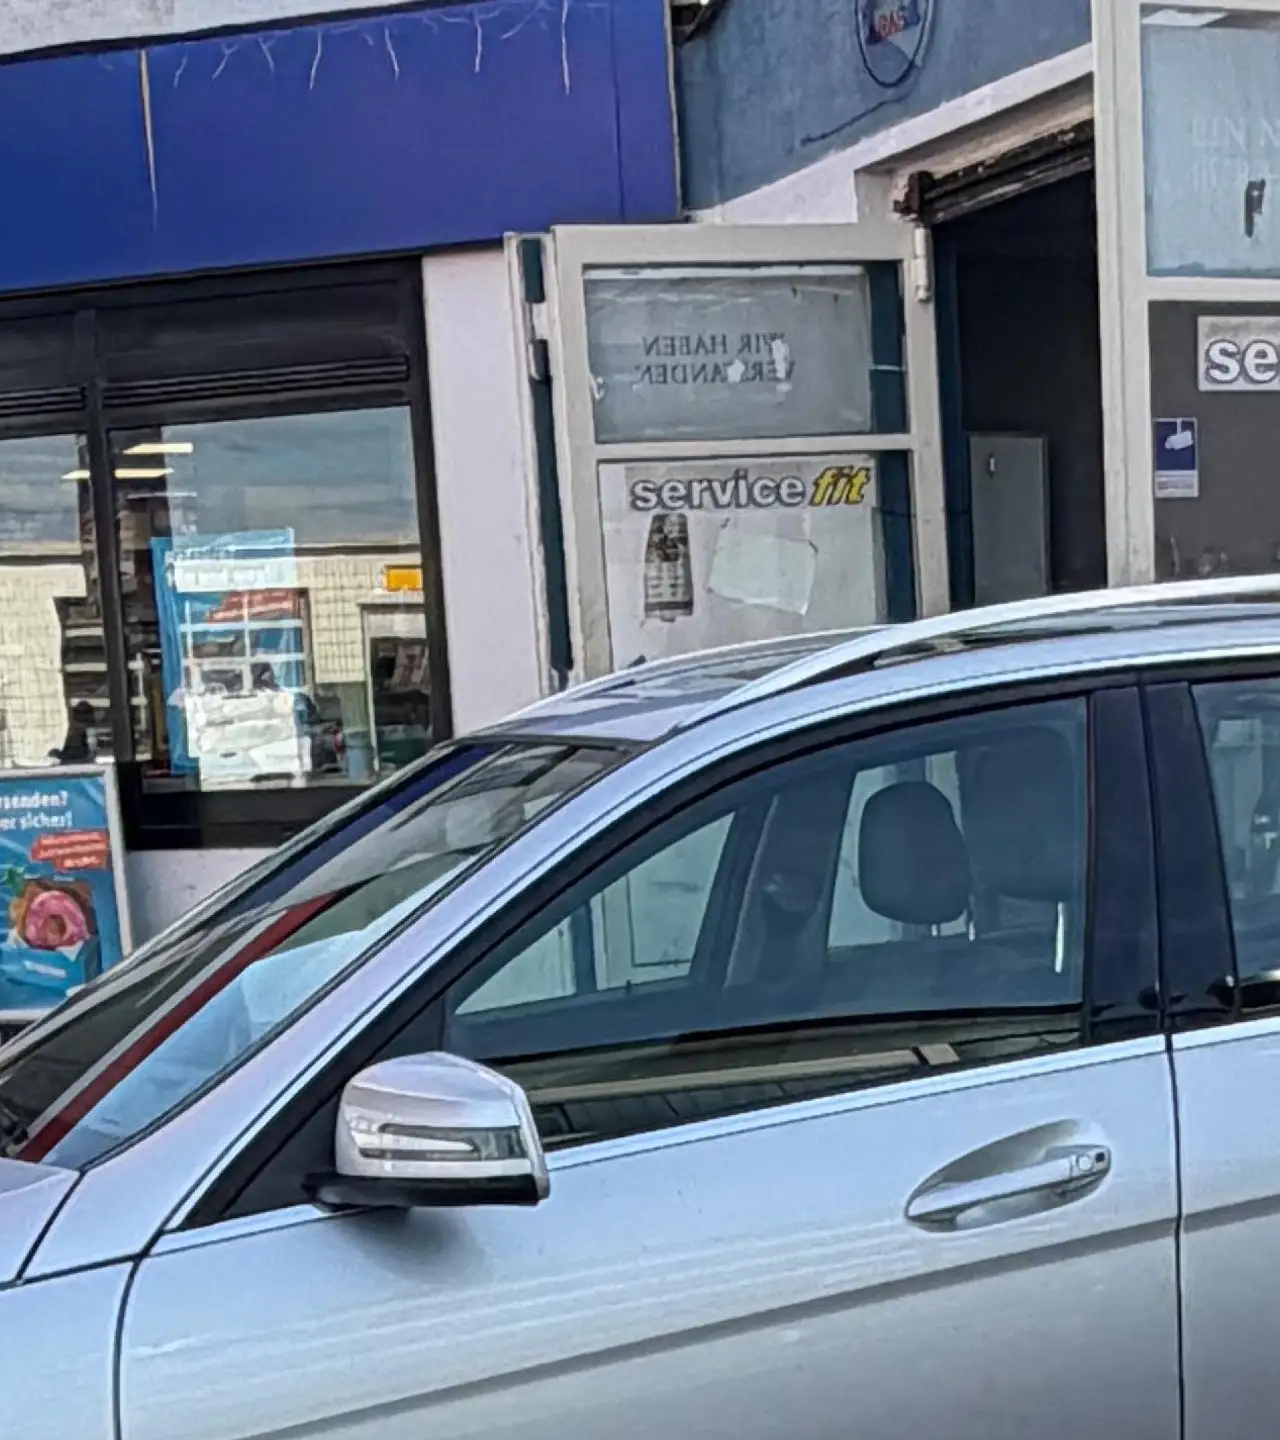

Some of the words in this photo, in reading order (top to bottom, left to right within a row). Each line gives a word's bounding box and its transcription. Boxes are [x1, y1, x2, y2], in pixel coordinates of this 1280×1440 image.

[628, 468, 807, 511] service
[808, 465, 873, 506] fit
[18, 809, 73, 830] sicher!
